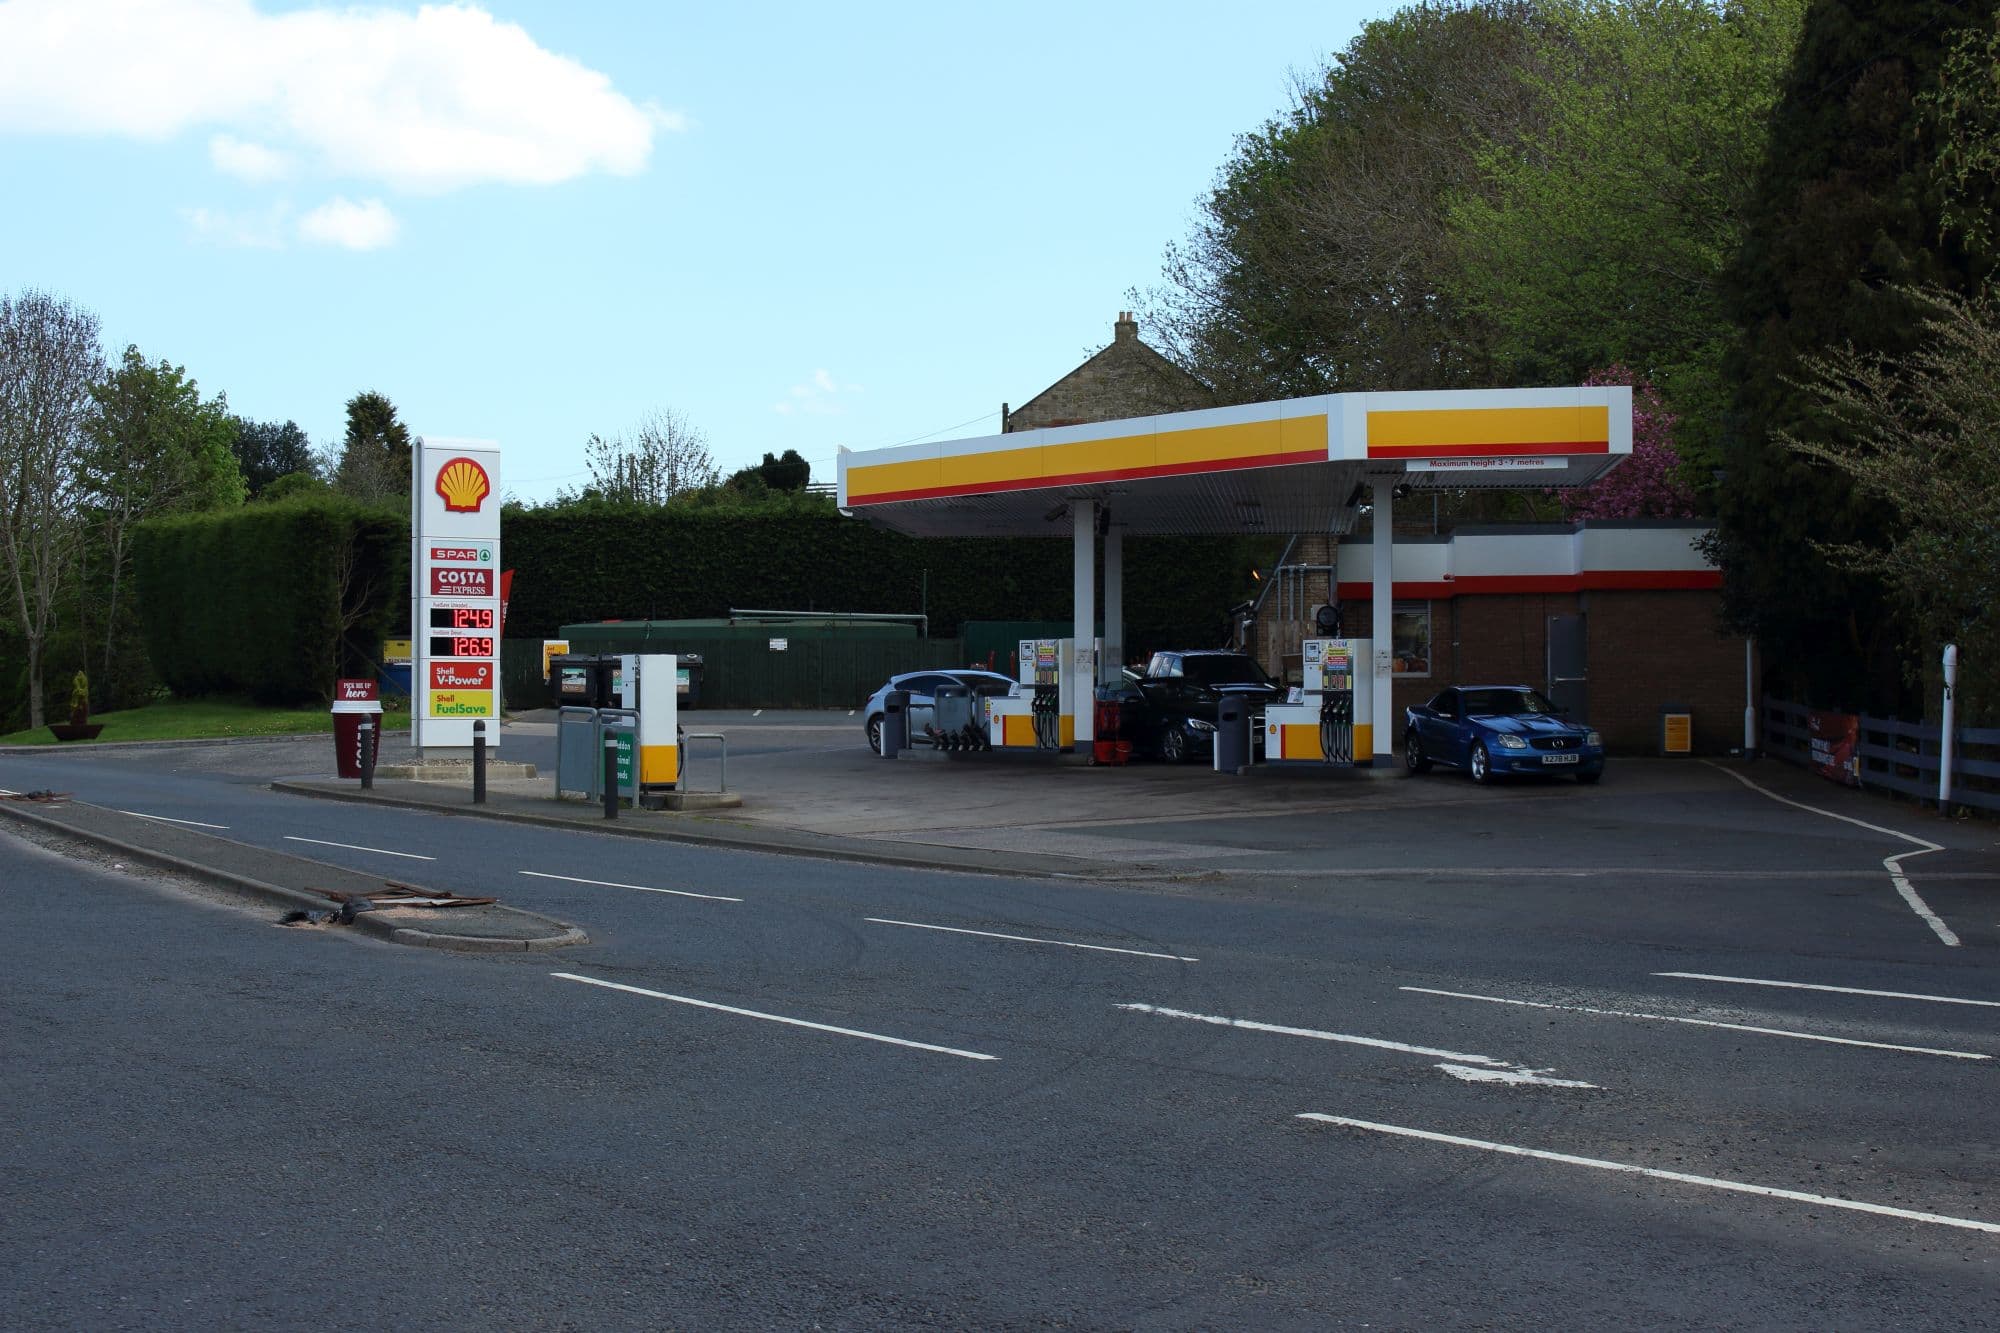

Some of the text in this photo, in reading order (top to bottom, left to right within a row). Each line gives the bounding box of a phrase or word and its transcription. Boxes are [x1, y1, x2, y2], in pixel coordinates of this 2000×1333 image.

[1429, 459, 1469, 468] Maximum
[1470, 459, 1496, 469] height
[436, 549, 477, 559] SPAR
[438, 570, 486, 585] COSTA
[452, 585, 486, 595] EXPRESS
[453, 609, 492, 628] 124.9
[453, 637, 492, 656] 126.9
[436, 666, 455, 675] Shell
[436, 675, 484, 685] V-Power
[345, 687, 369, 698] here
[436, 694, 455, 703] Shell
[436, 702, 487, 714] FuelSave
